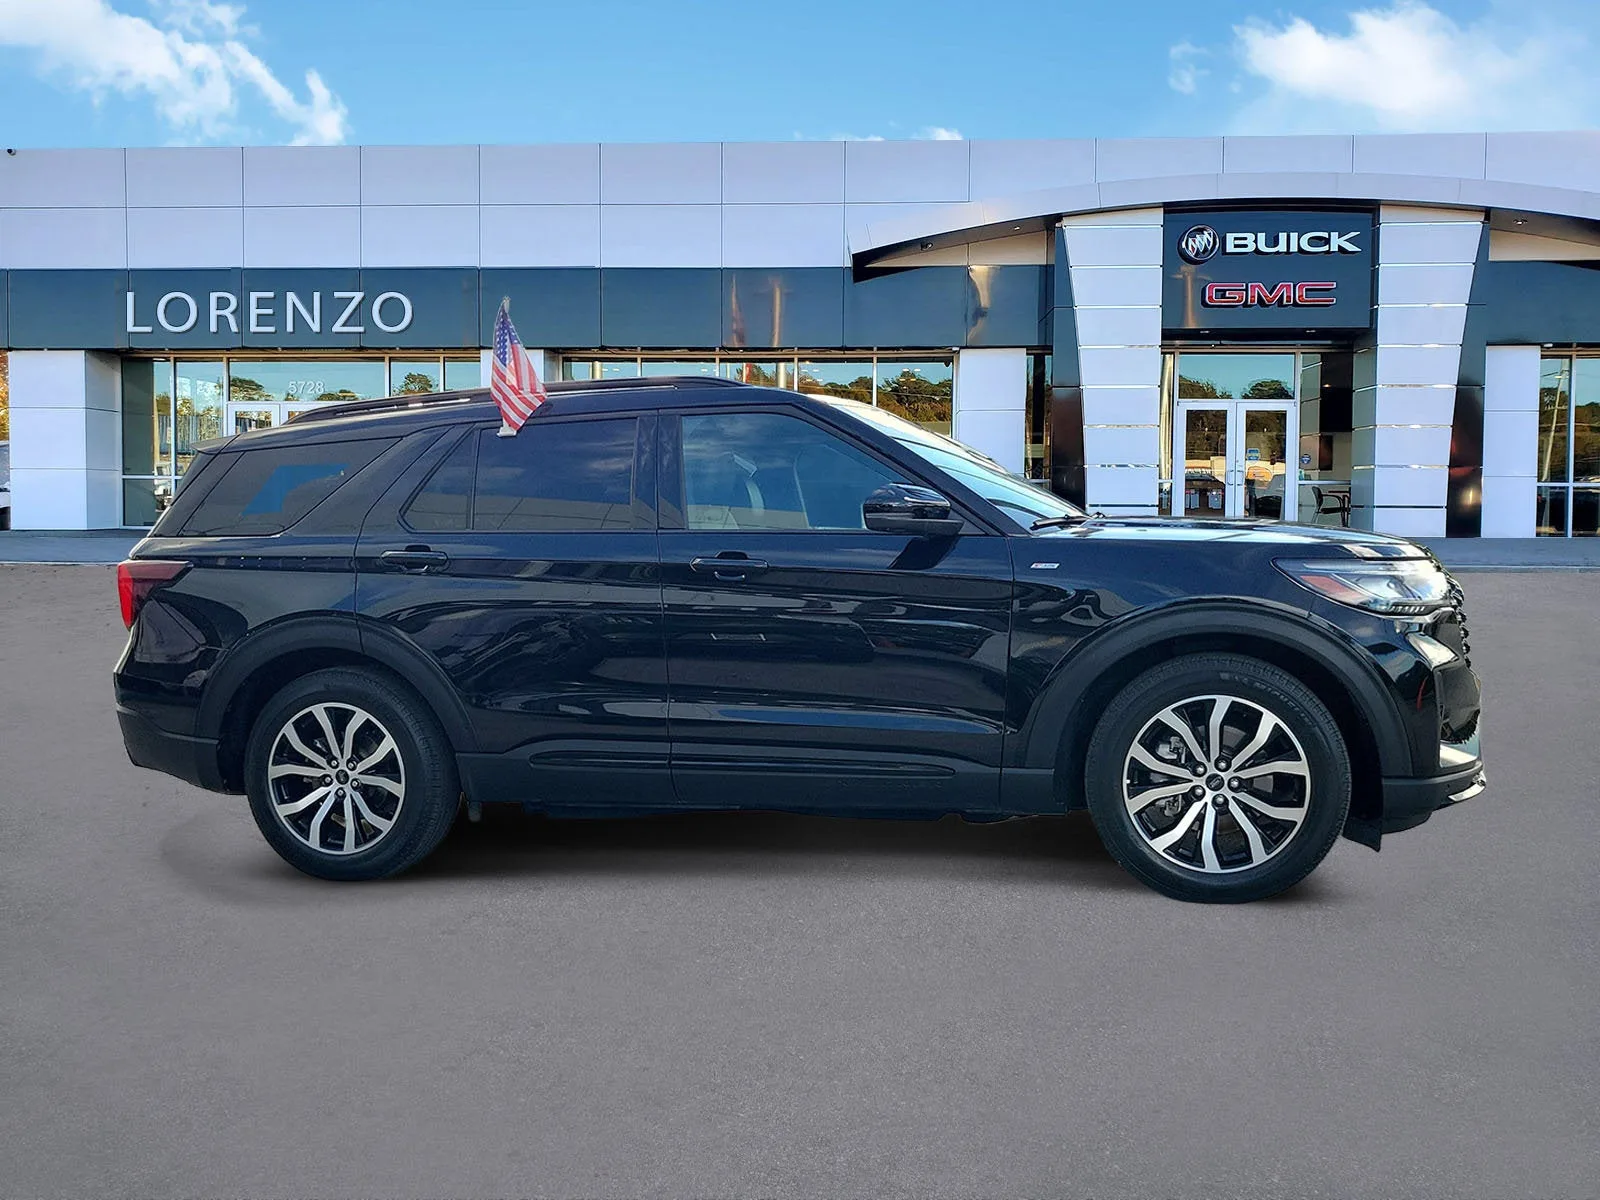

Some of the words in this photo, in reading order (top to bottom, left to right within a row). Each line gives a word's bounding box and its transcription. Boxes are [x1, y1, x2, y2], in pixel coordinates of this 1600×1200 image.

[1225, 231, 1362, 253] BUICK
[1205, 281, 1337, 305] GMC
[126, 291, 413, 333] LORENZO
[288, 380, 325, 394] 5728
